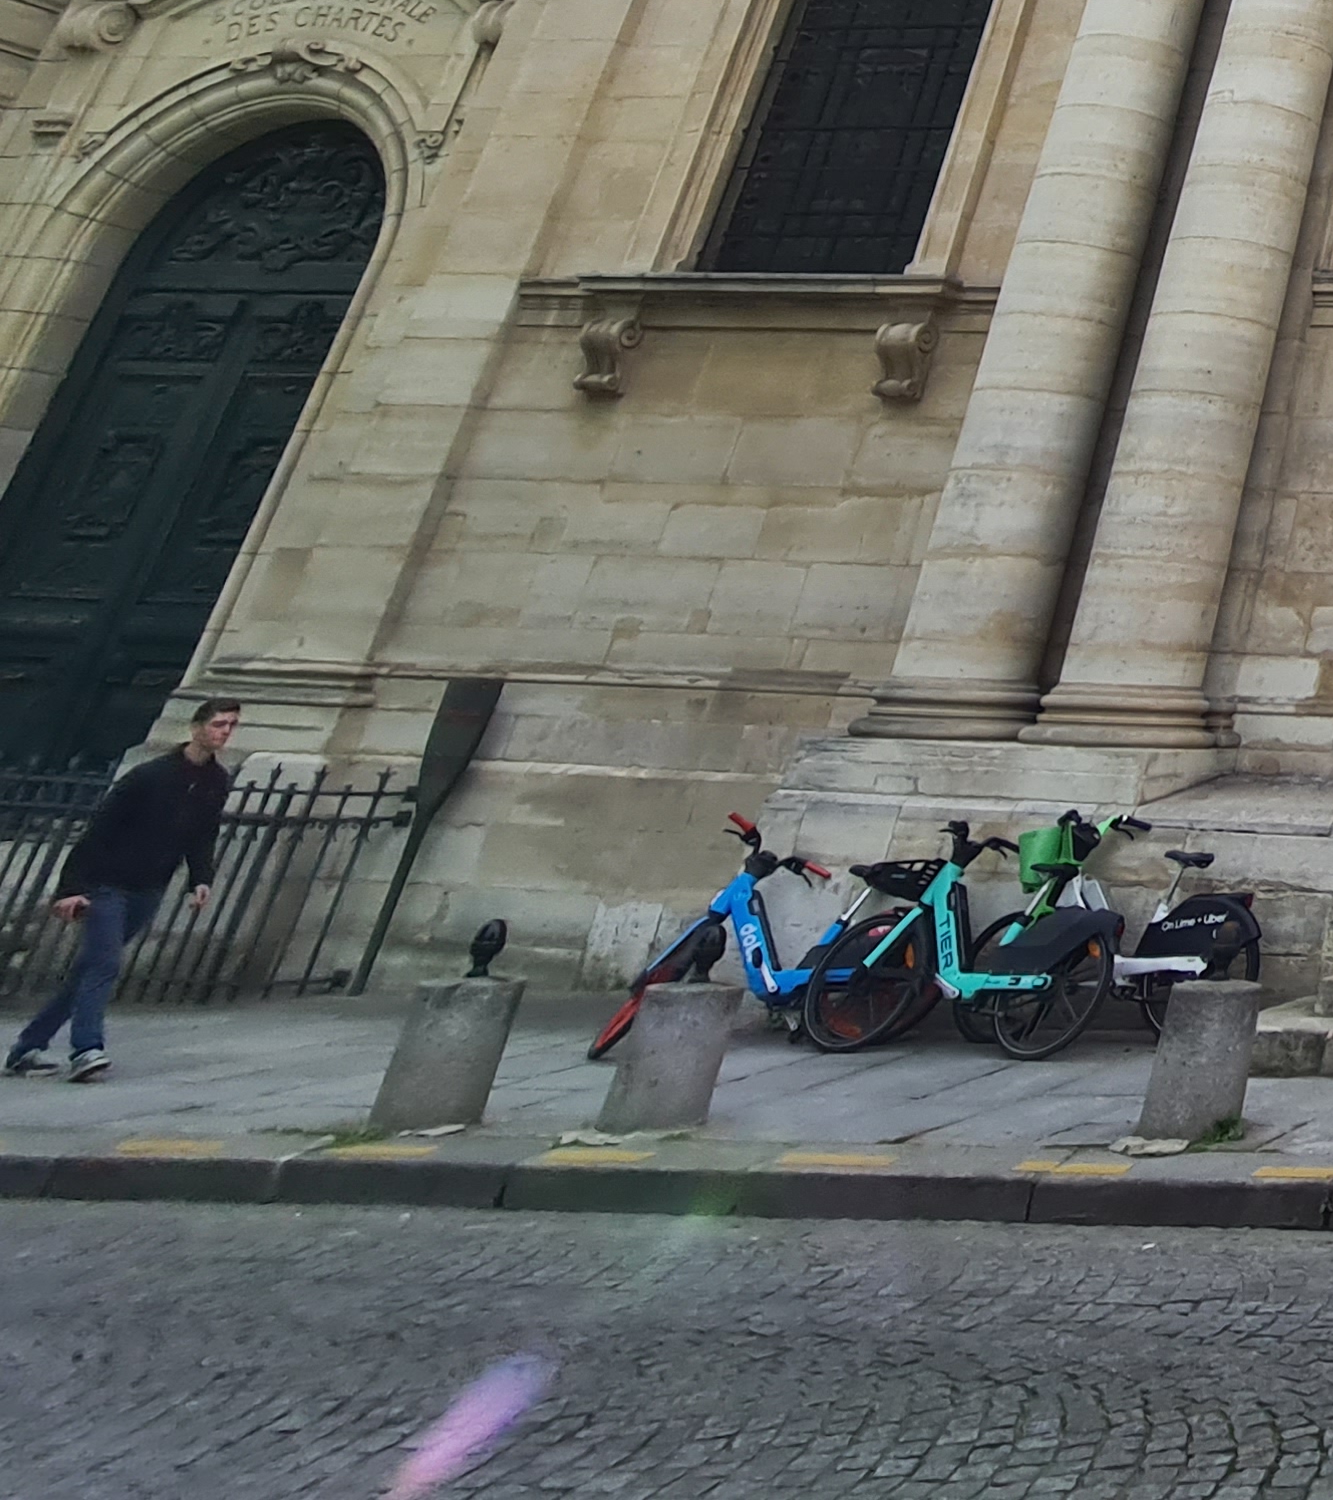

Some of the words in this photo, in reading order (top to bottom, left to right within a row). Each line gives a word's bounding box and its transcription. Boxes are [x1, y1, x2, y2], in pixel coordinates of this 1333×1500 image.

[225, 10, 280, 43] DES
[294, 5, 407, 43] CHARTES
[1175, 917, 1196, 929] Lime
[1203, 911, 1229, 925] Uber
[739, 922, 763, 963] dot
[938, 912, 955, 970] TIER
